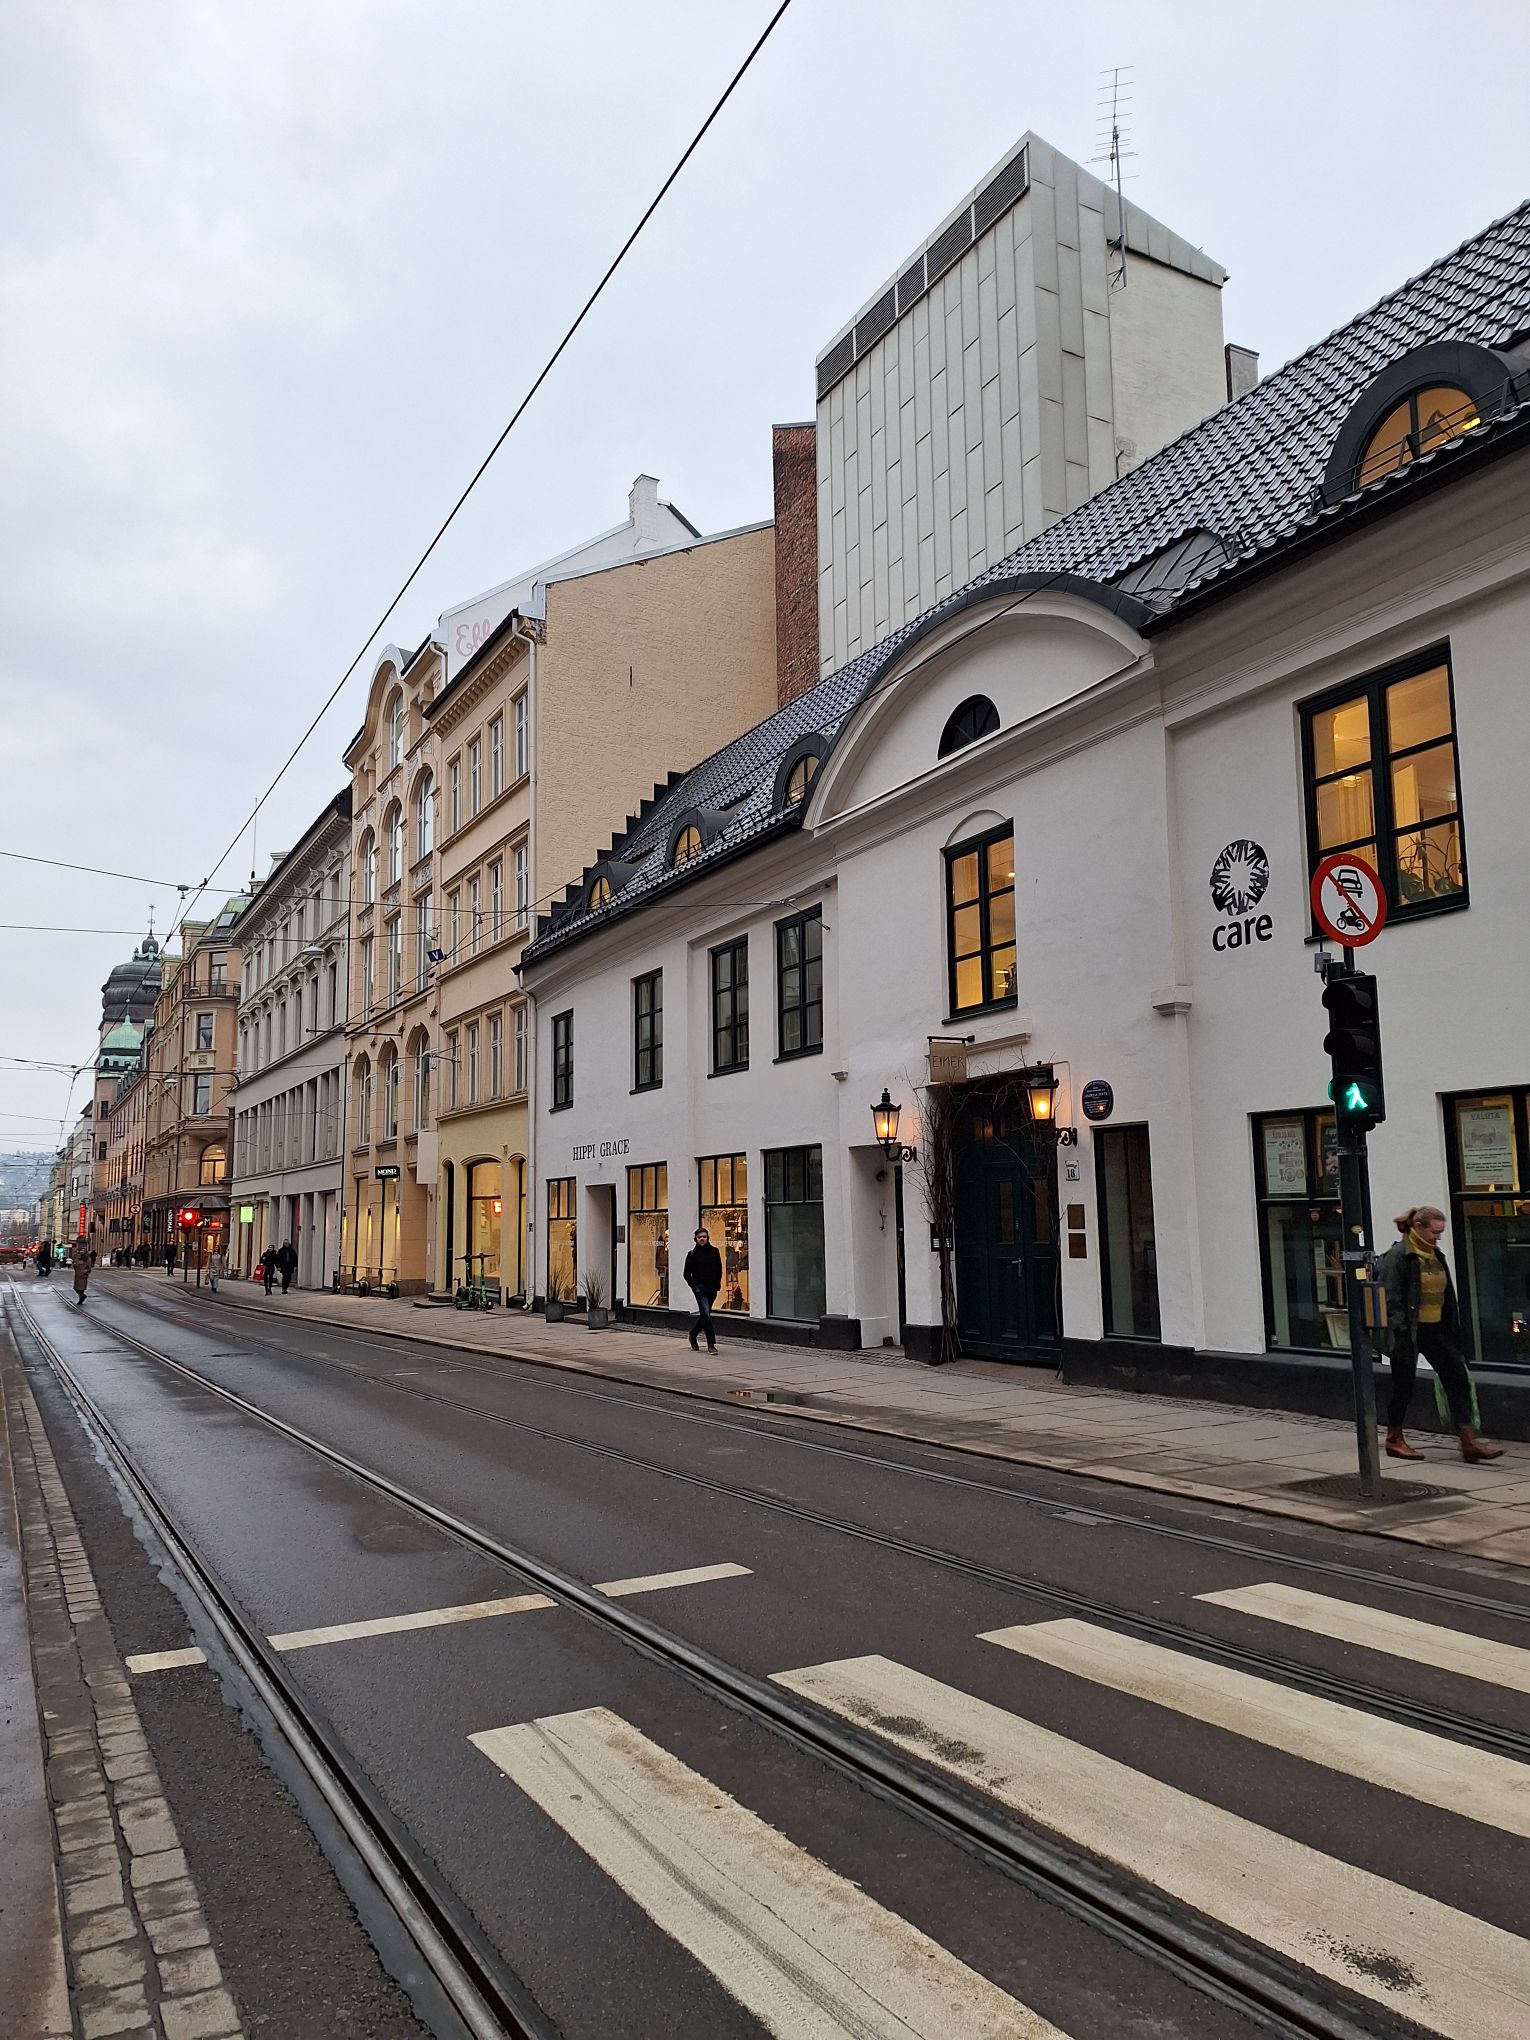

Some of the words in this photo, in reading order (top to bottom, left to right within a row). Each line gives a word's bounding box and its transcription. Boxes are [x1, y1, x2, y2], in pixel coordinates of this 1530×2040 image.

[1212, 913, 1273, 952] care
[432, 951, 439, 960] V
[572, 1143, 596, 1161] HIPPI
[599, 1138, 630, 1158] GRACE
[1067, 1168, 1076, 1178] 18
